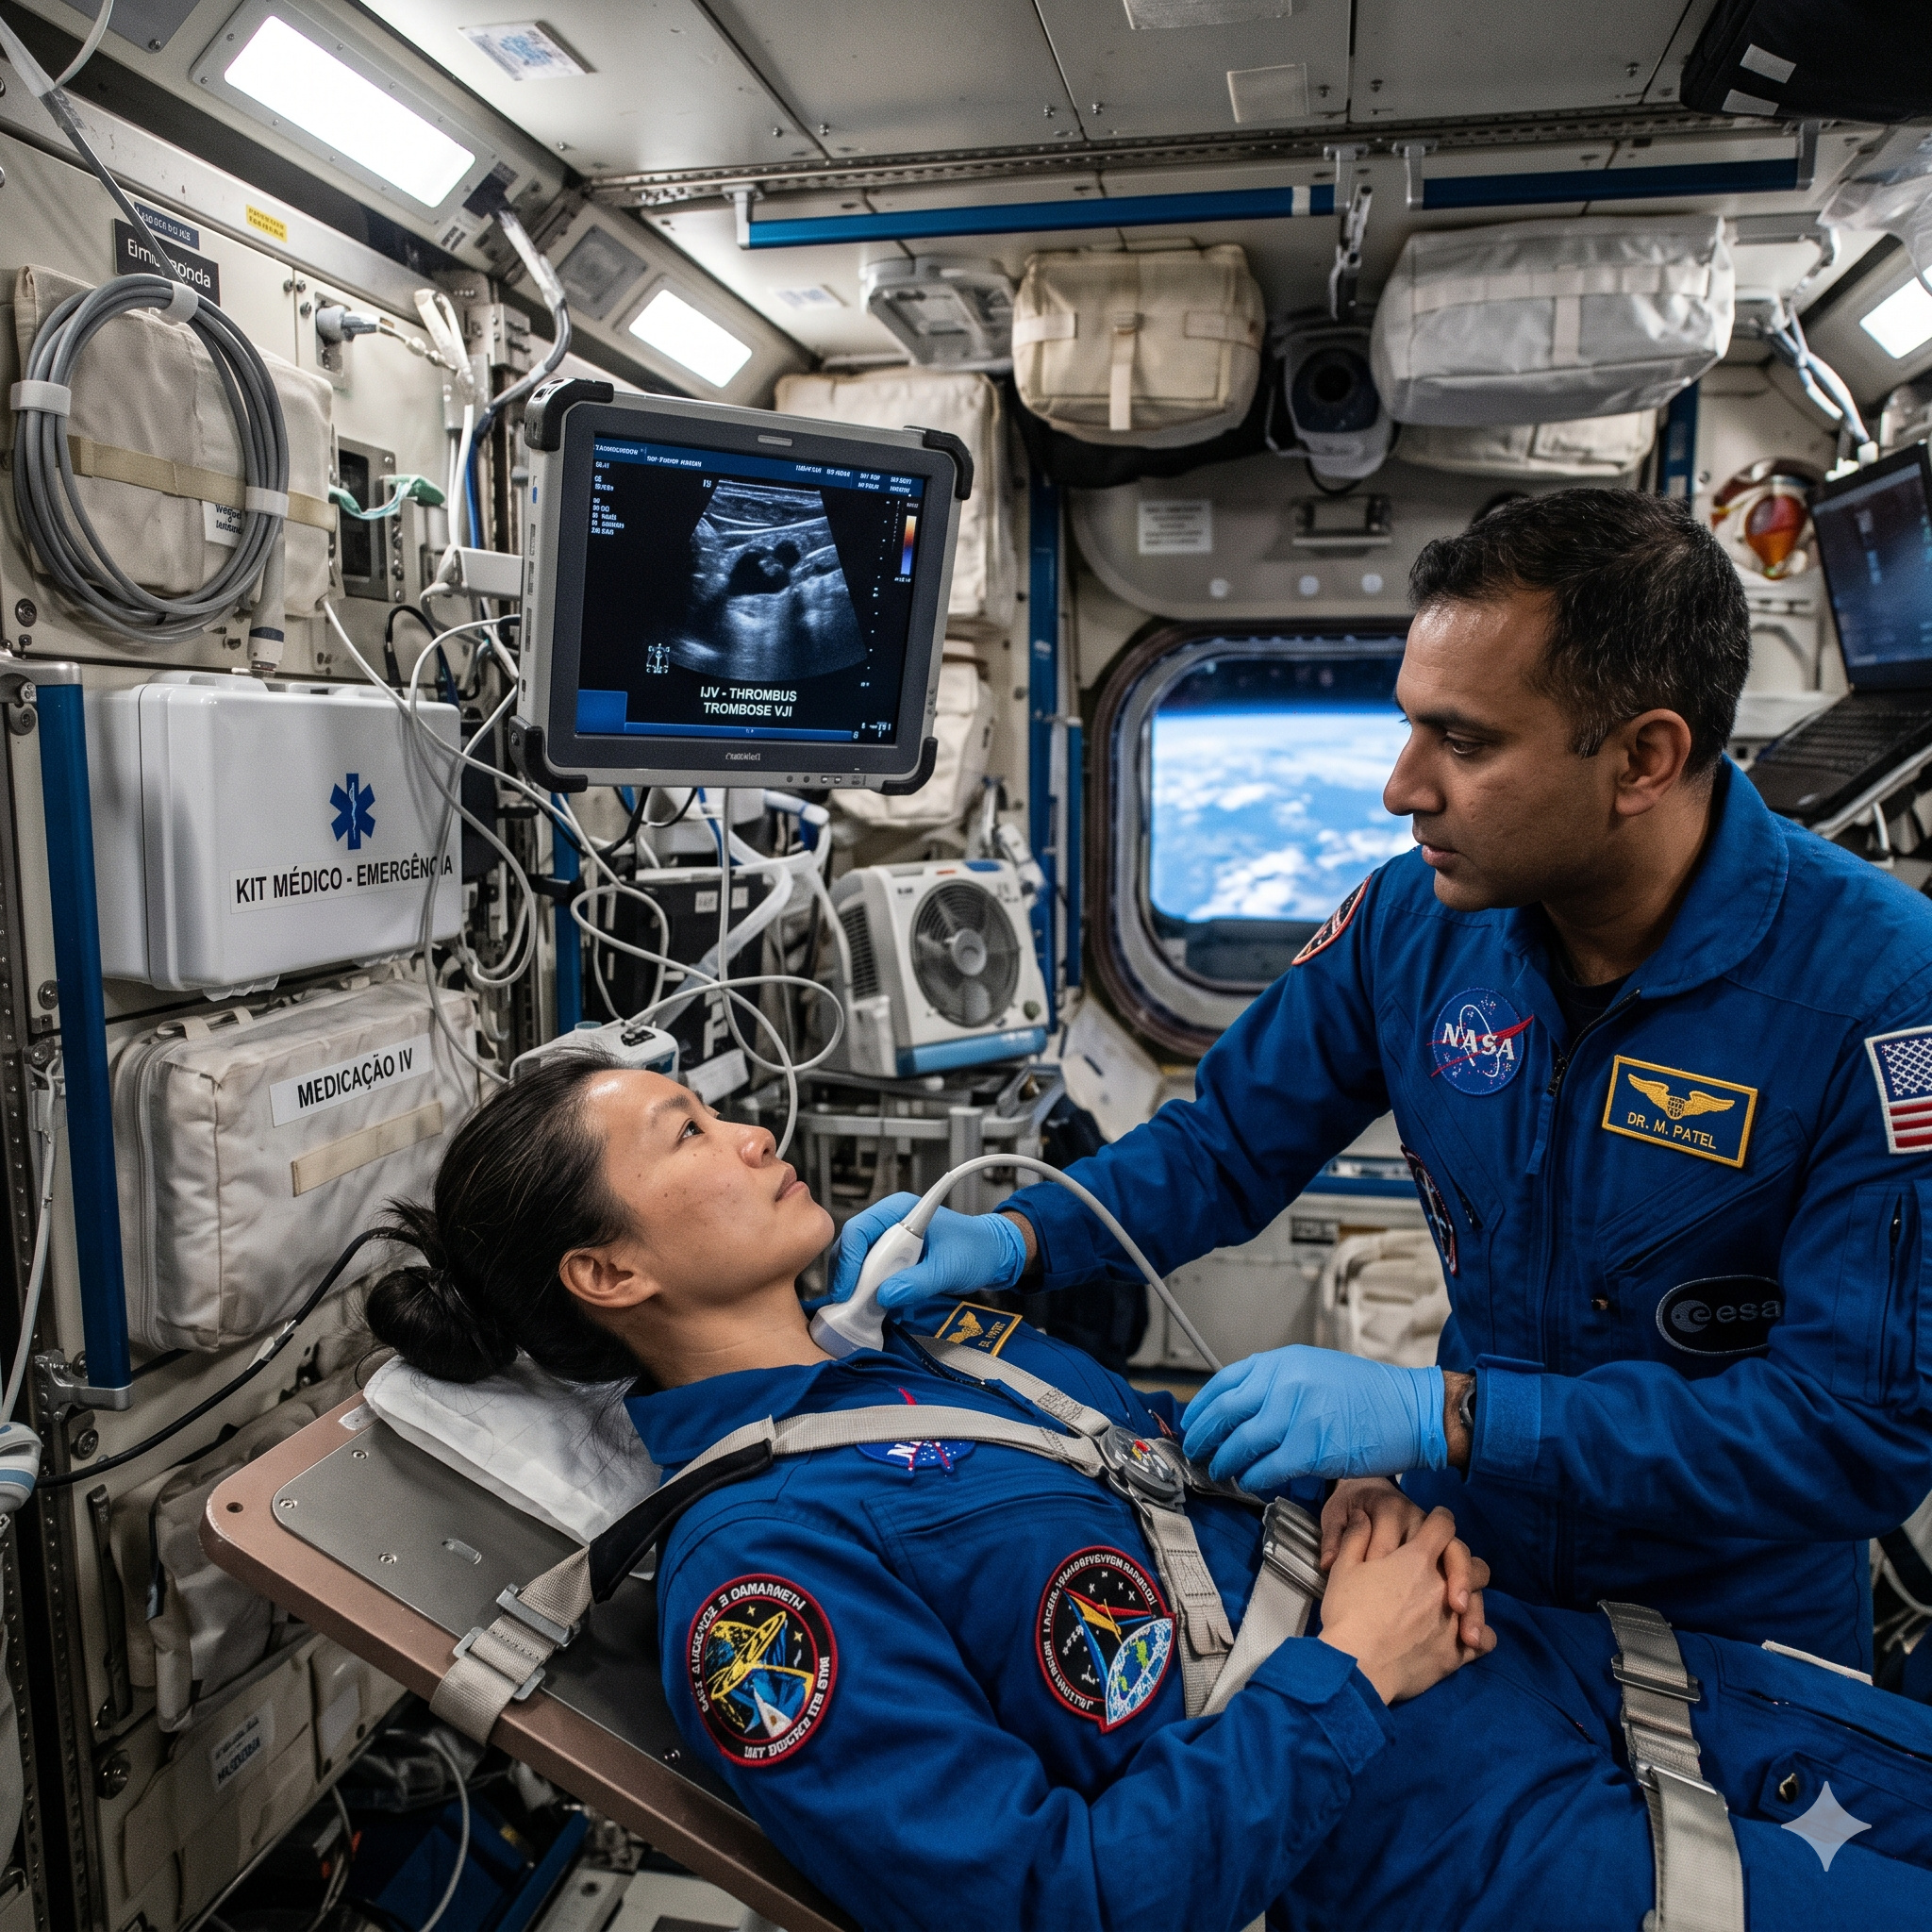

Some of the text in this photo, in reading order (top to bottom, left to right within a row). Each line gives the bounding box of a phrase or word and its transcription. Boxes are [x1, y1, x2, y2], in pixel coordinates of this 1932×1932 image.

[700, 686, 720, 698] IJV
[729, 688, 797, 702] THROMBUS
[704, 702, 792, 717] TROMBOSE VJI
[236, 876, 267, 904] KIT
[274, 866, 342, 898] MÉDICO
[1441, 1023, 1515, 1060] NASA
[297, 1047, 412, 1108] MEDICAÇÃO IV
[1627, 1111, 1716, 1150] DR. M. PATEL
[1716, 1300, 1782, 1324] esa
